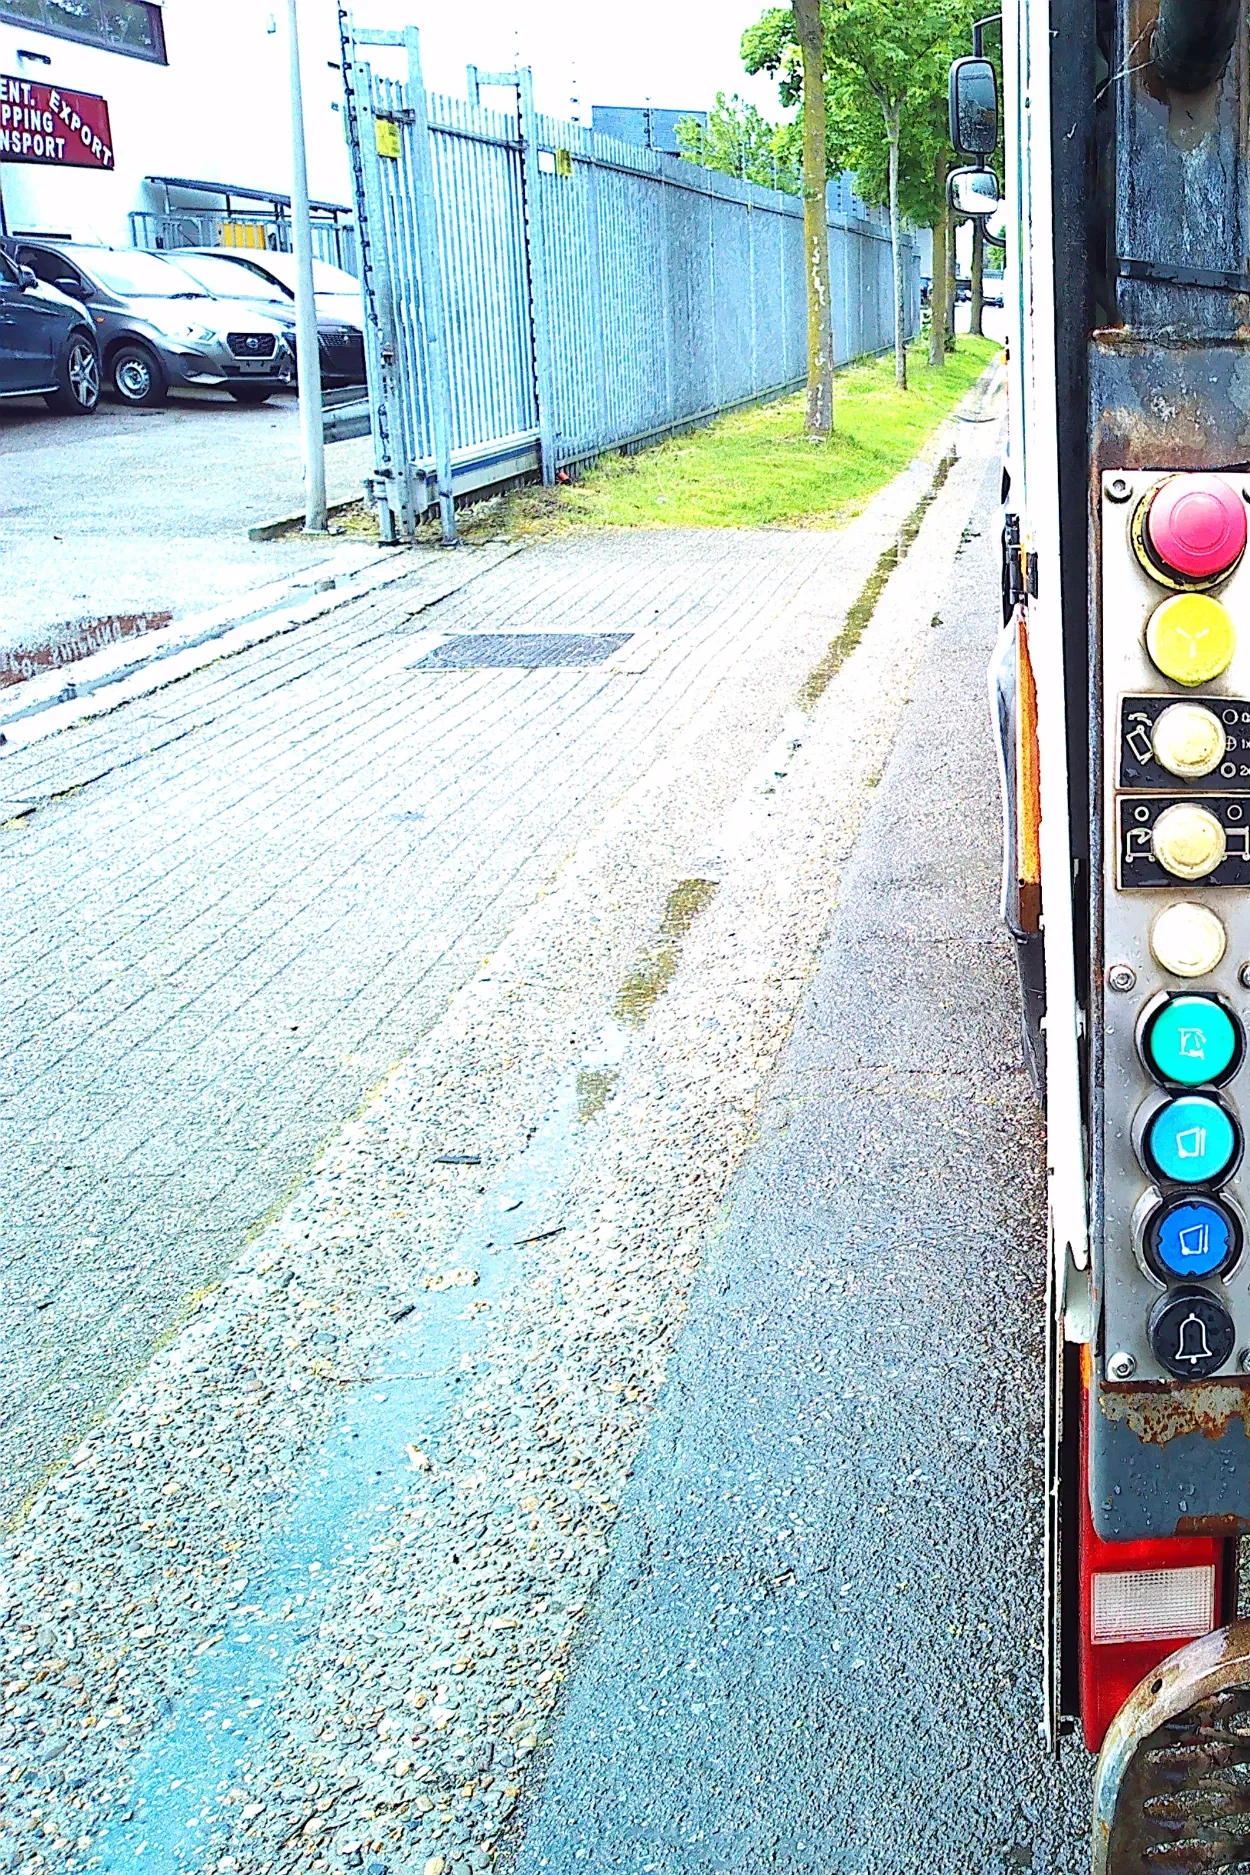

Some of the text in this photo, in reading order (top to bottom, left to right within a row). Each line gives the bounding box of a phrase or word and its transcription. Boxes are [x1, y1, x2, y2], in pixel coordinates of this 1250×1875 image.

[1, 103, 53, 133] PPING
[49, 89, 112, 165] EXPORT
[0, 129, 65, 158] NSPORT
